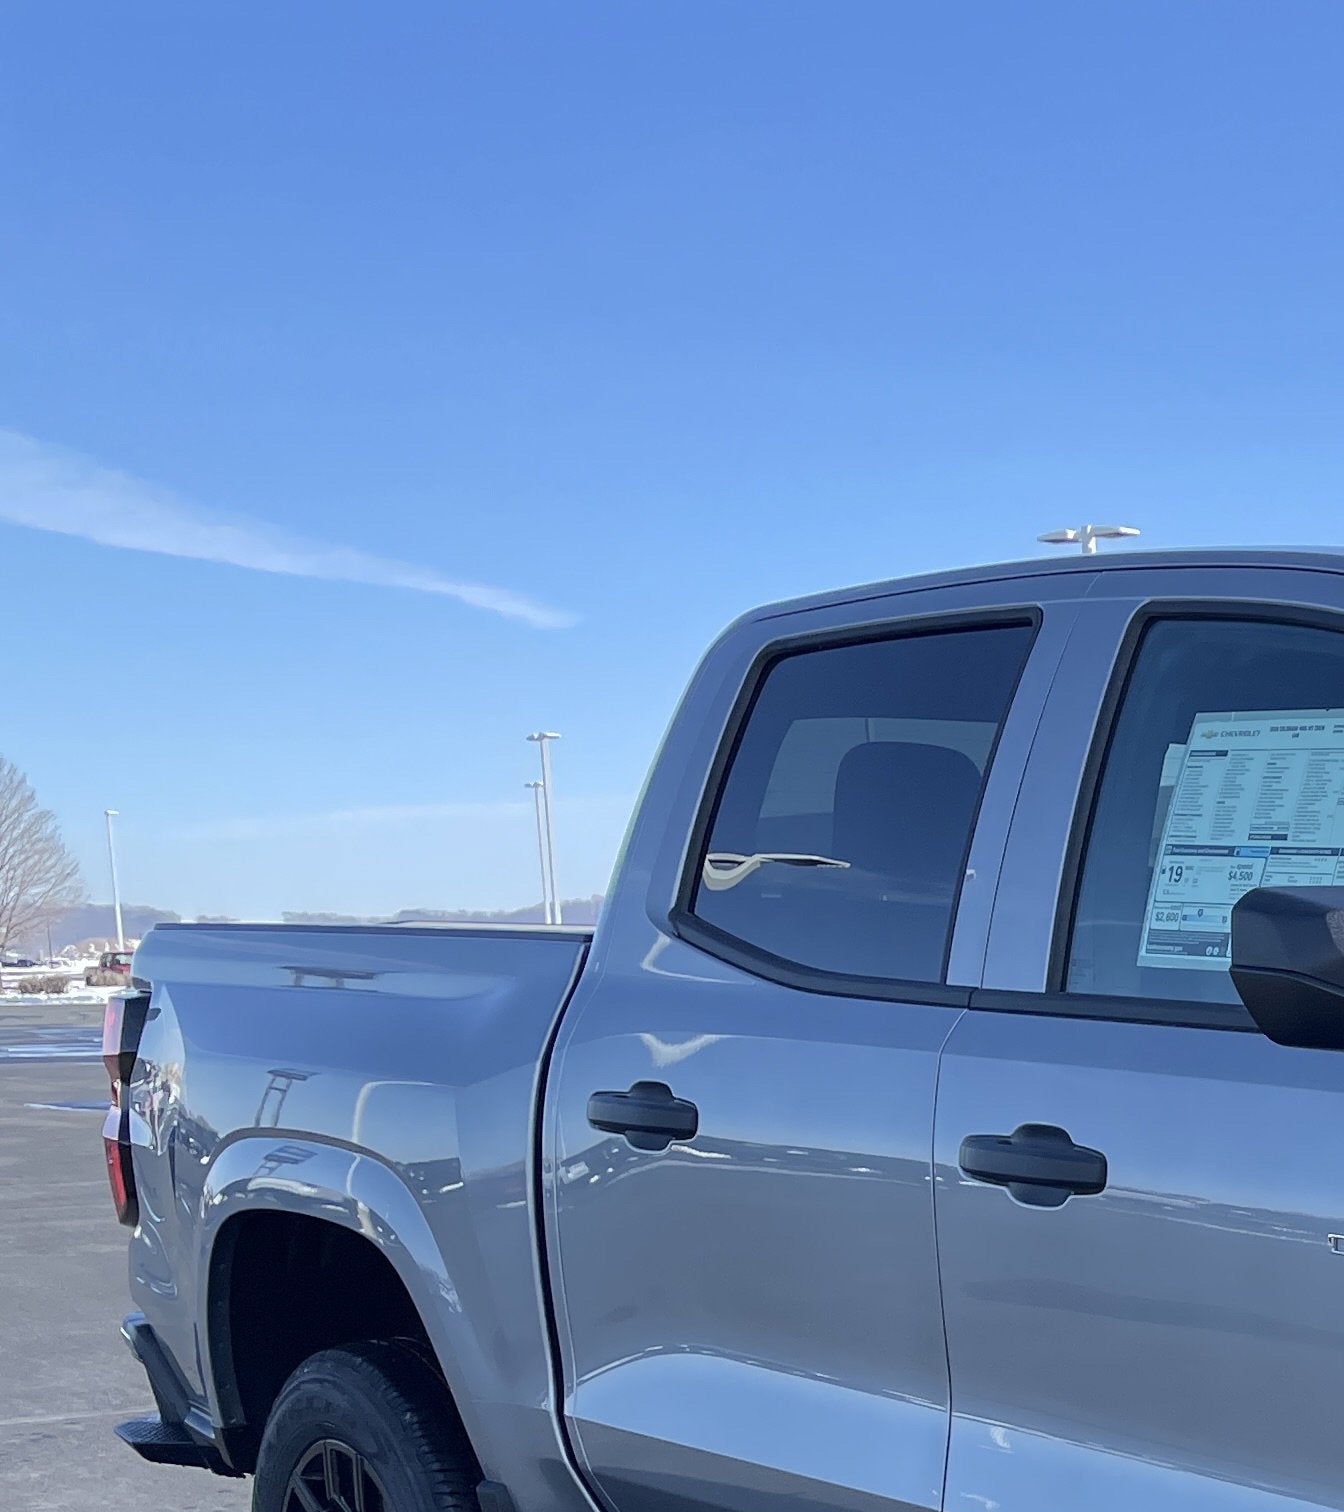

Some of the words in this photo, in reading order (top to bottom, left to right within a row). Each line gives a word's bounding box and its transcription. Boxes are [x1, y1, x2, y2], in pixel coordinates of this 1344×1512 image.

[1220, 730, 1261, 738] CHEVROLET
[1168, 865, 1183, 883] 19
[1228, 870, 1254, 881] $4,500
